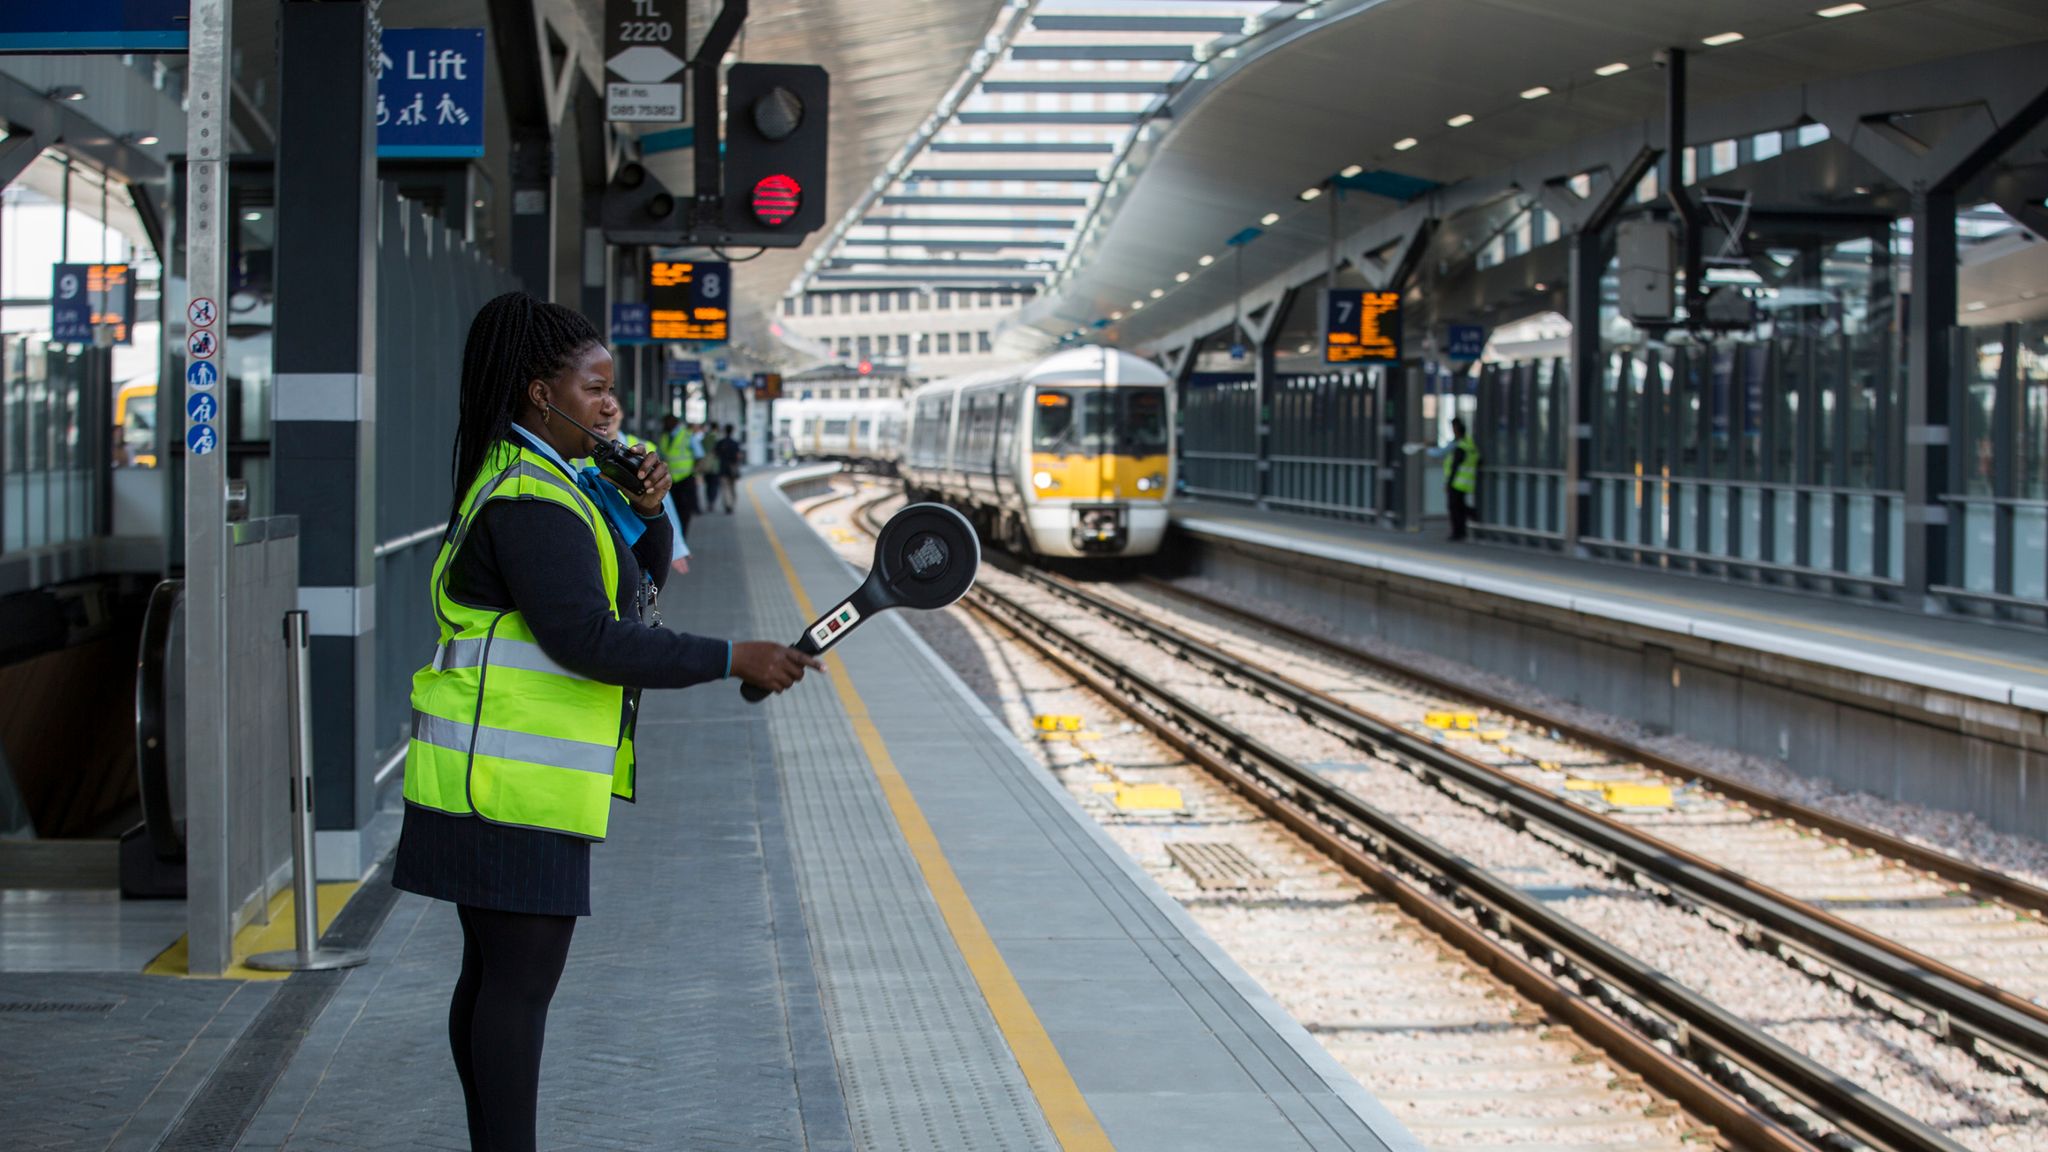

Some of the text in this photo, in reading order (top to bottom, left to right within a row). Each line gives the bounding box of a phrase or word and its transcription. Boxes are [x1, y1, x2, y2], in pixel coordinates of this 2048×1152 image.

[632, 0, 660, 17] TL
[620, 22, 673, 42] 2220
[407, 49, 467, 80] Lift
[60, 273, 78, 299] 9
[702, 273, 721, 298] 8
[1336, 302, 1353, 323] 7
